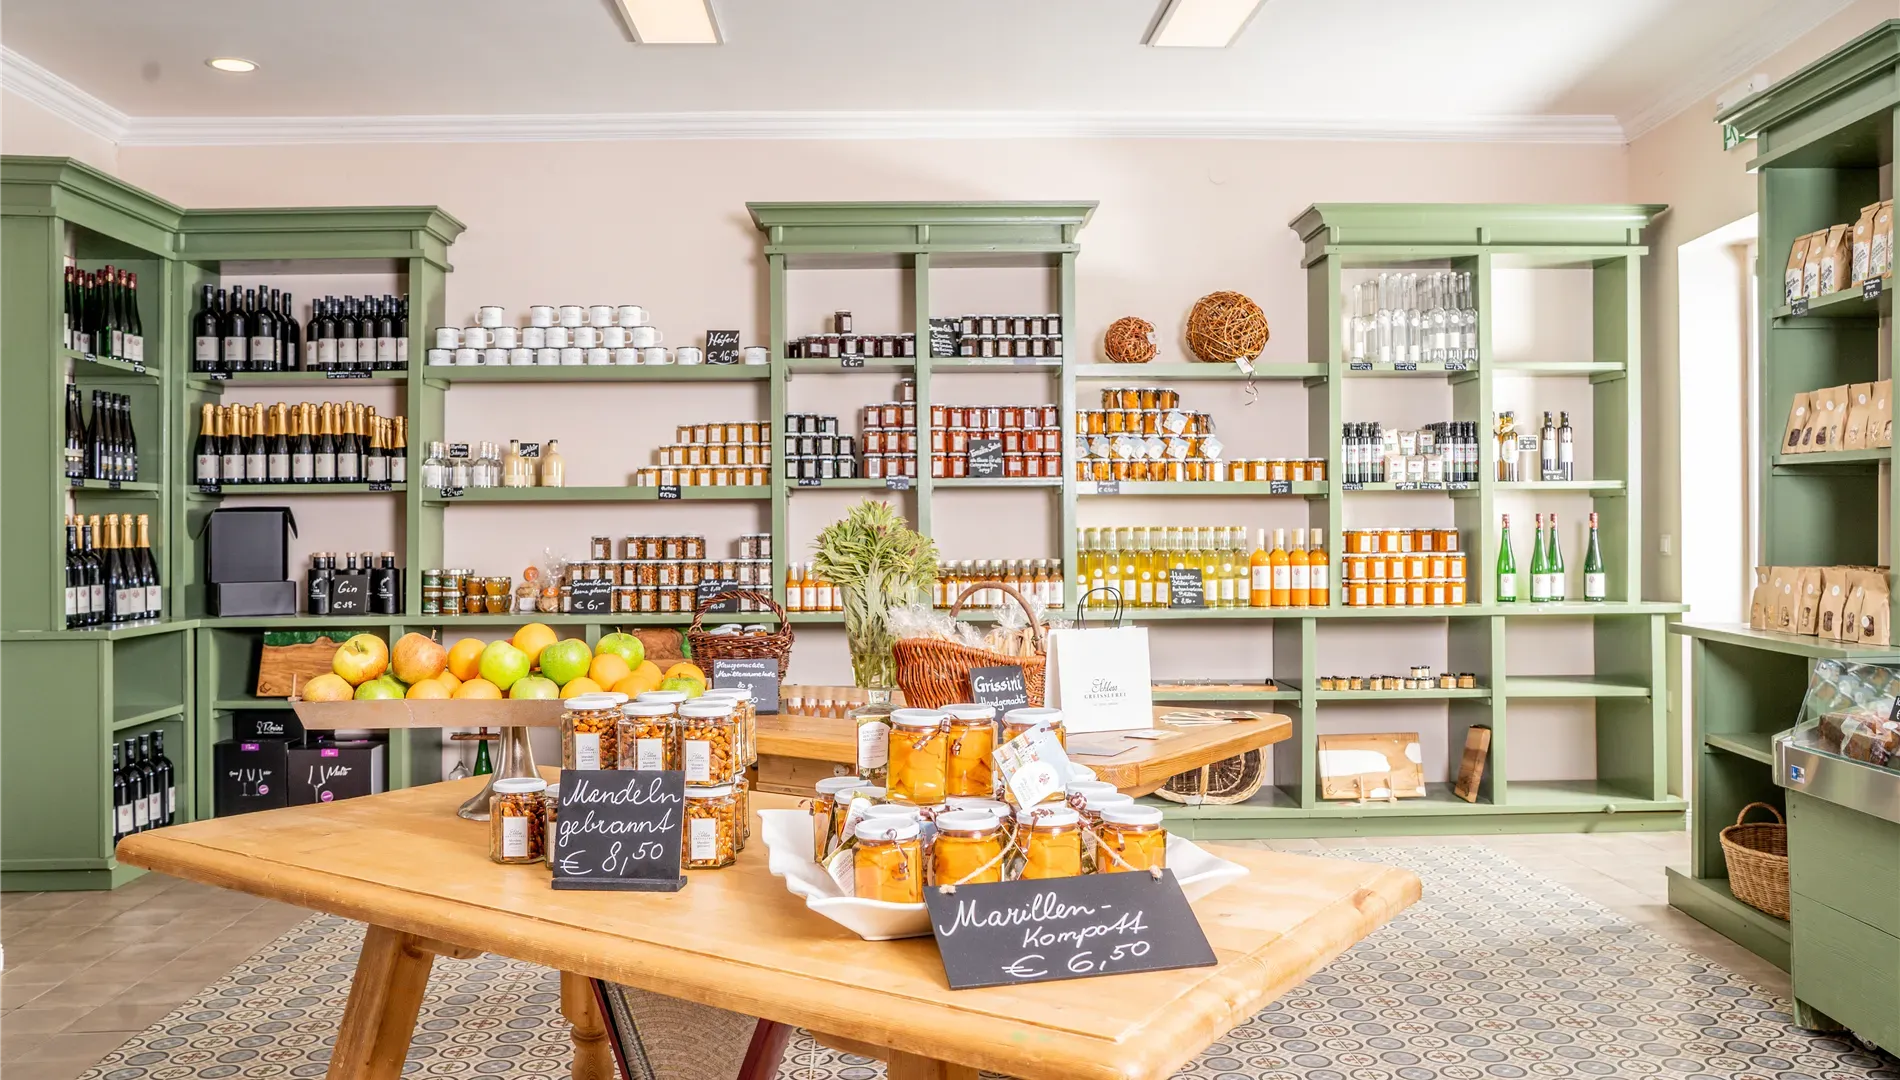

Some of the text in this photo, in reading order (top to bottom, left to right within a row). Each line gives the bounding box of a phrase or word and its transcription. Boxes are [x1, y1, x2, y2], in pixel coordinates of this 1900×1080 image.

[337, 580, 358, 594] Gin
[574, 600, 585, 610] €
[973, 674, 1023, 693] Grissini
[563, 776, 681, 806] Mandeln
[559, 807, 676, 848] gebrannt
[559, 841, 664, 876] € 8,50
[1022, 910, 1149, 949] Kompott
[1001, 940, 1151, 978] € 6,50
